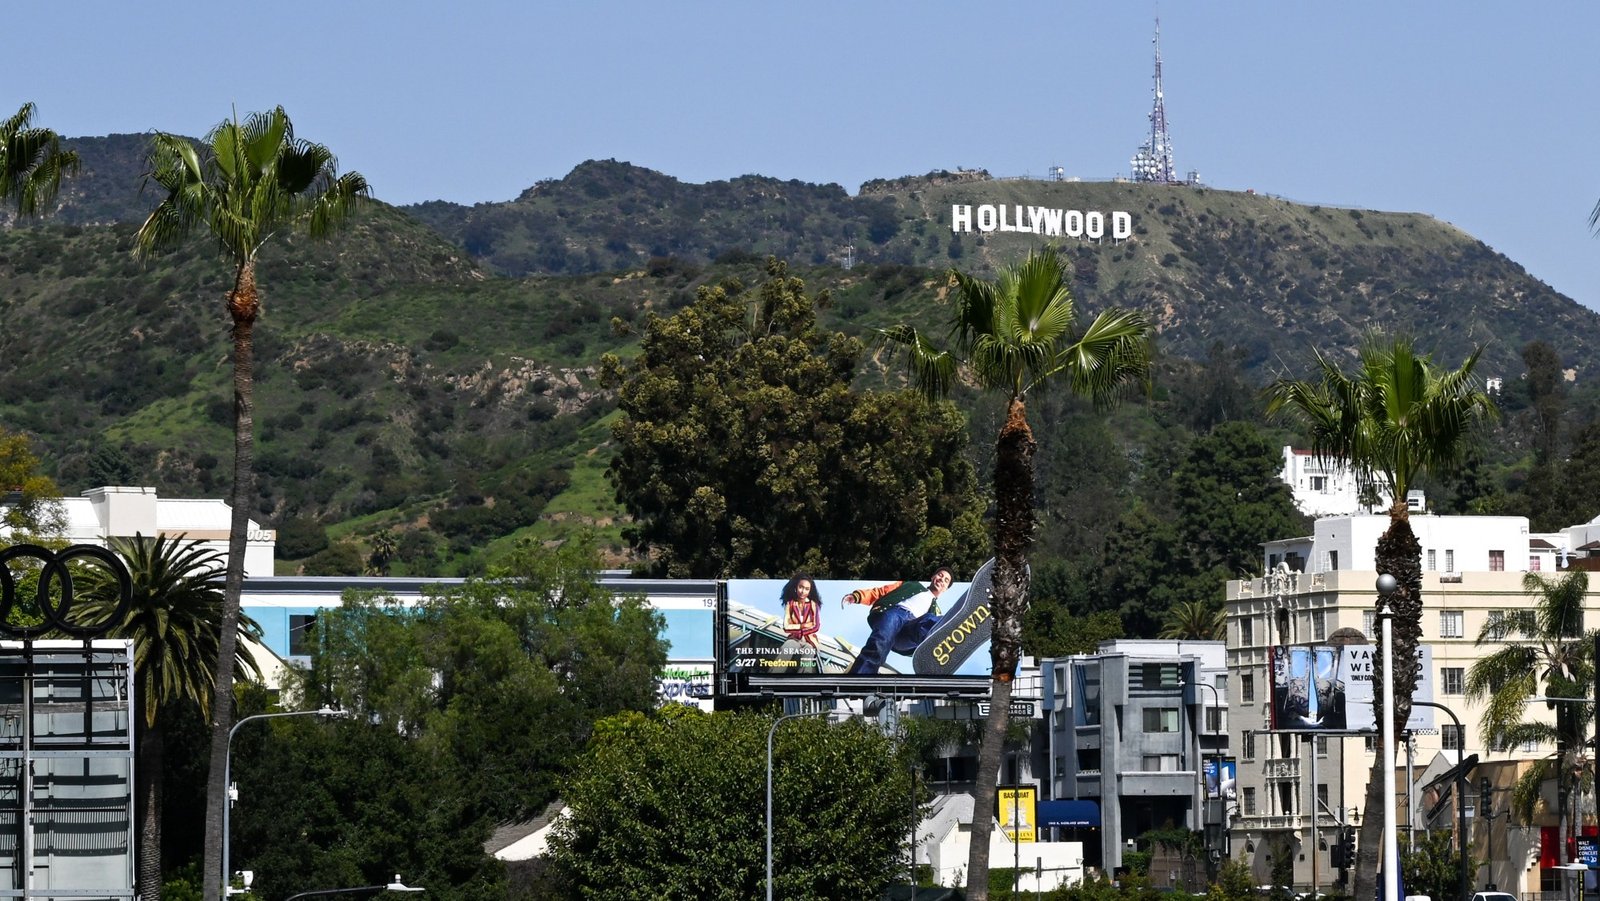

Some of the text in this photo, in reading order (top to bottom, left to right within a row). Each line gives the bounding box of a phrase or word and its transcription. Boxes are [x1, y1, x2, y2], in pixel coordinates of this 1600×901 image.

[952, 204, 1132, 240] HOLLYWOOD
[246, 530, 272, 541] 005
[933, 604, 991, 666] grown
[735, 647, 817, 655] THE FINAL SEASON
[735, 658, 756, 667] 3/27
[760, 658, 798, 667] Freeform
[661, 682, 710, 699] xpress
[1003, 791, 1029, 799] BASUIAT
